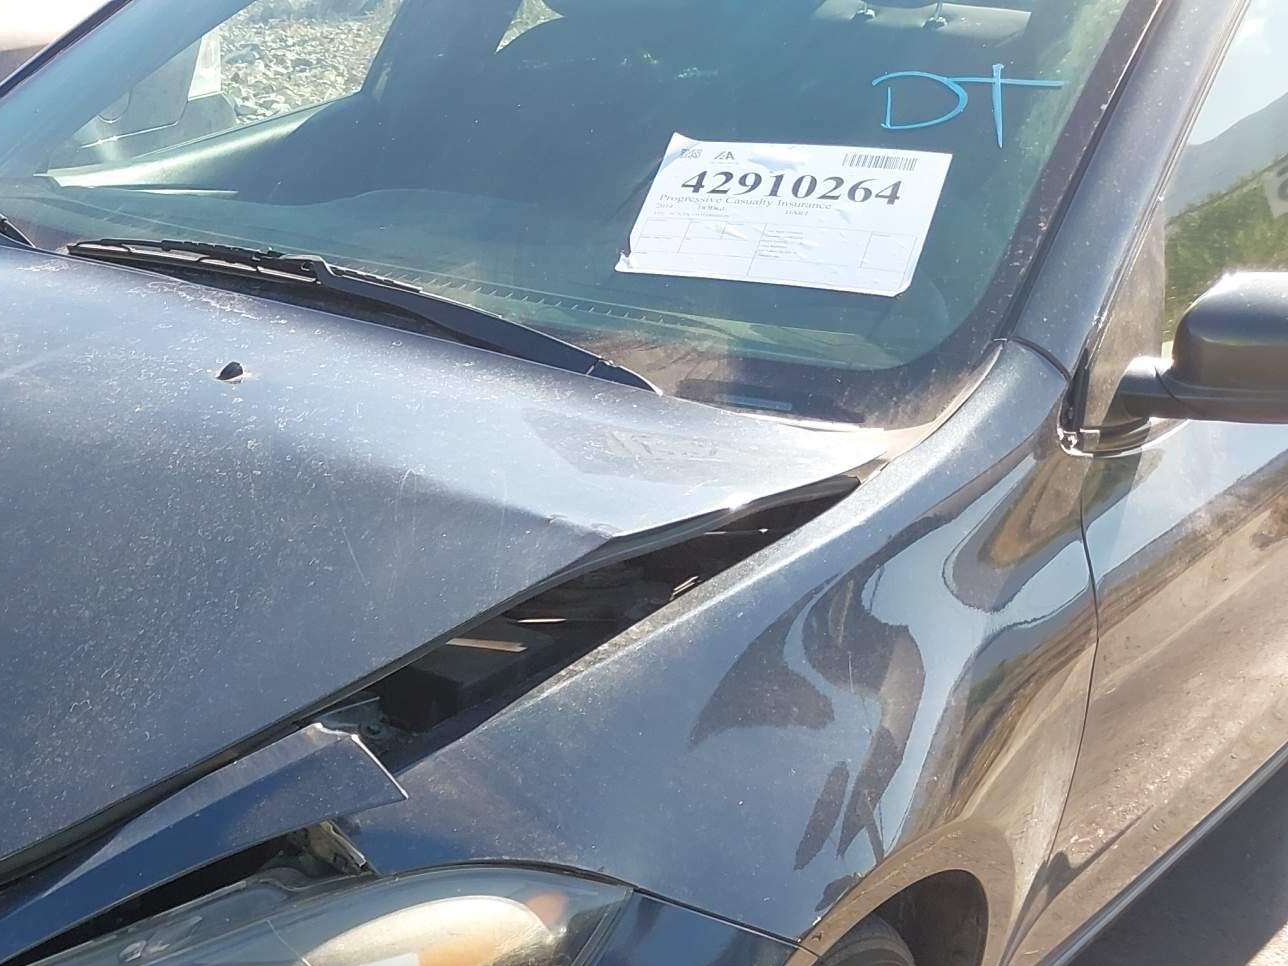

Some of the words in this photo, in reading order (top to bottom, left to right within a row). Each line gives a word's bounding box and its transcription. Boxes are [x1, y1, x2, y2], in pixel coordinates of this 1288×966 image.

[681, 170, 904, 206] 42910264
[659, 193, 723, 205] Progressive
[725, 196, 774, 208] Casualty
[777, 199, 832, 210] Insurance
